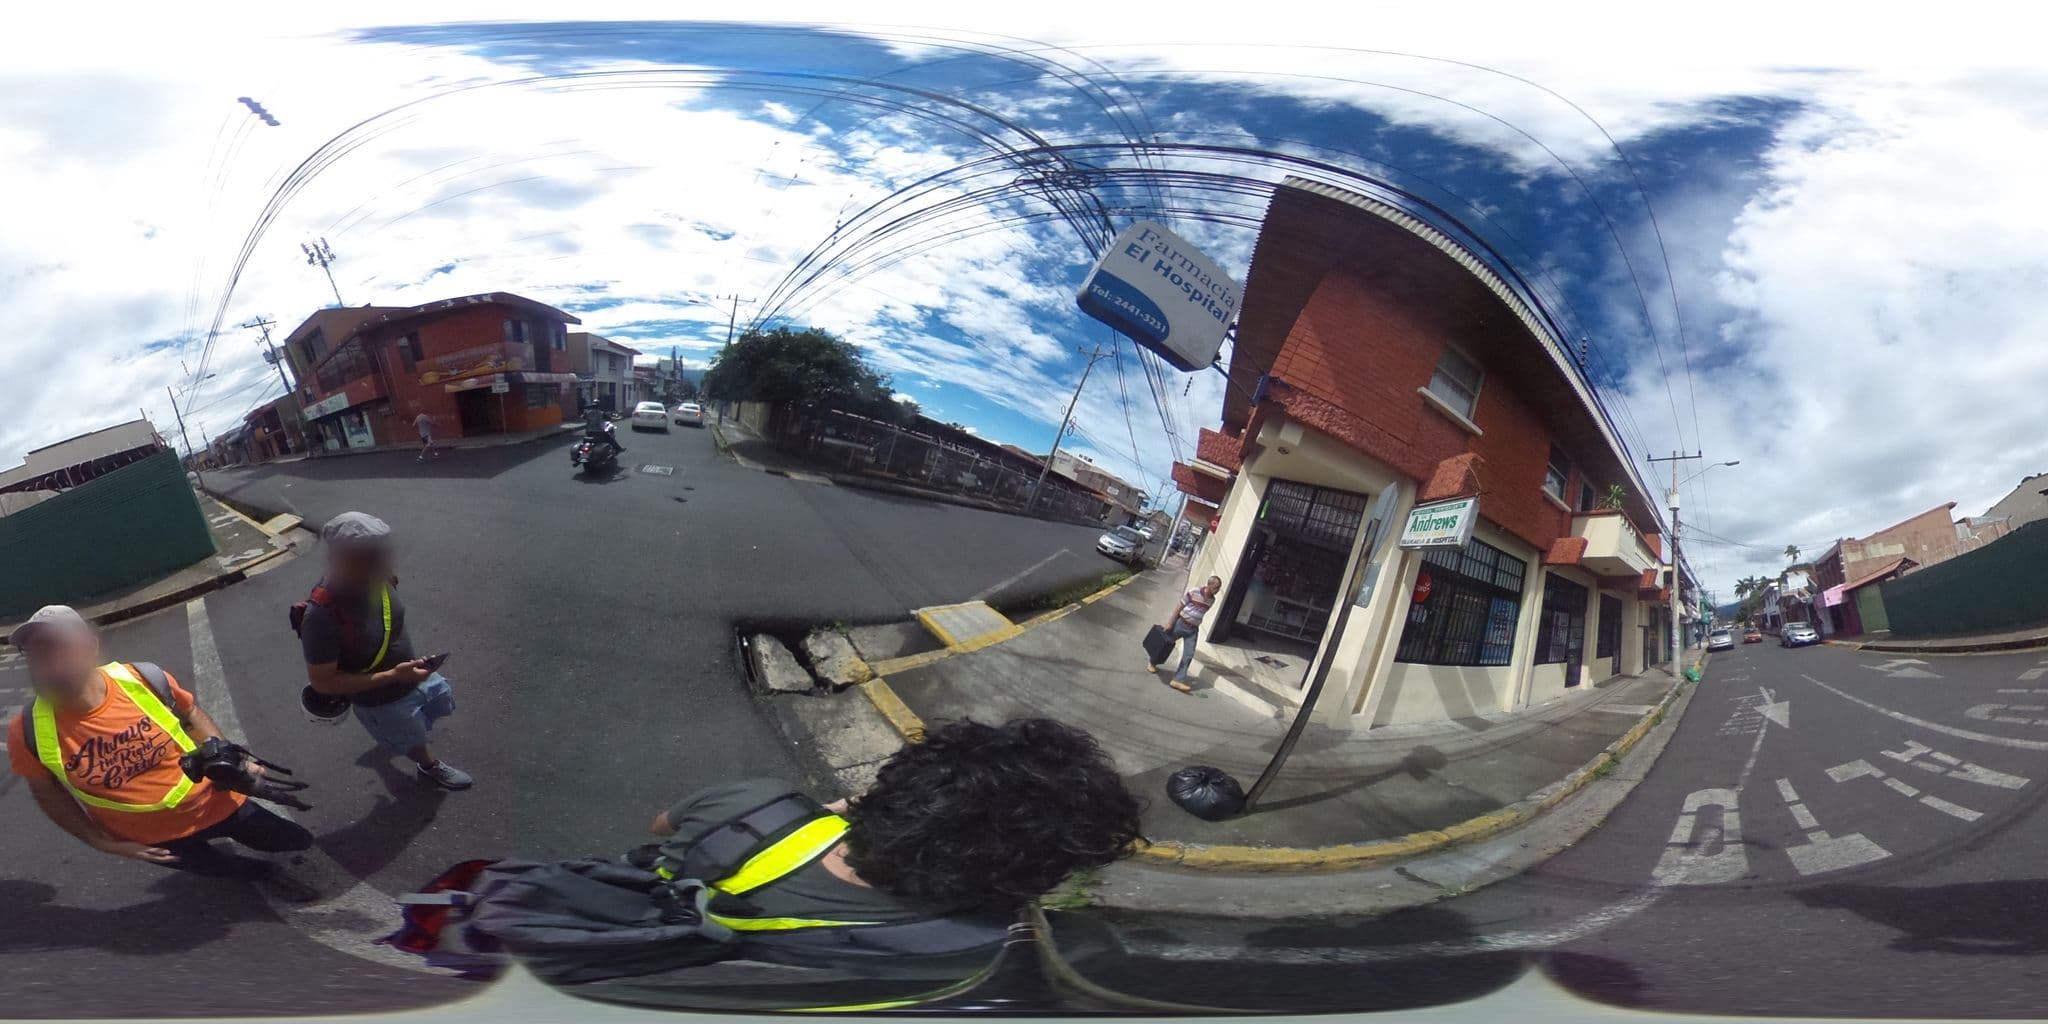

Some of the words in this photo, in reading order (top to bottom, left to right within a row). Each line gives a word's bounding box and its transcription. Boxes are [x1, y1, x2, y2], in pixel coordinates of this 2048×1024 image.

[1091, 284, 1112, 301] Tel:
[1125, 242, 1150, 263] El
[1153, 259, 1230, 324] Hospital
[1136, 228, 1235, 310] Farmacia
[1409, 514, 1458, 533] Andrews
[65, 717, 152, 778] Always
[115, 732, 162, 768] Right
